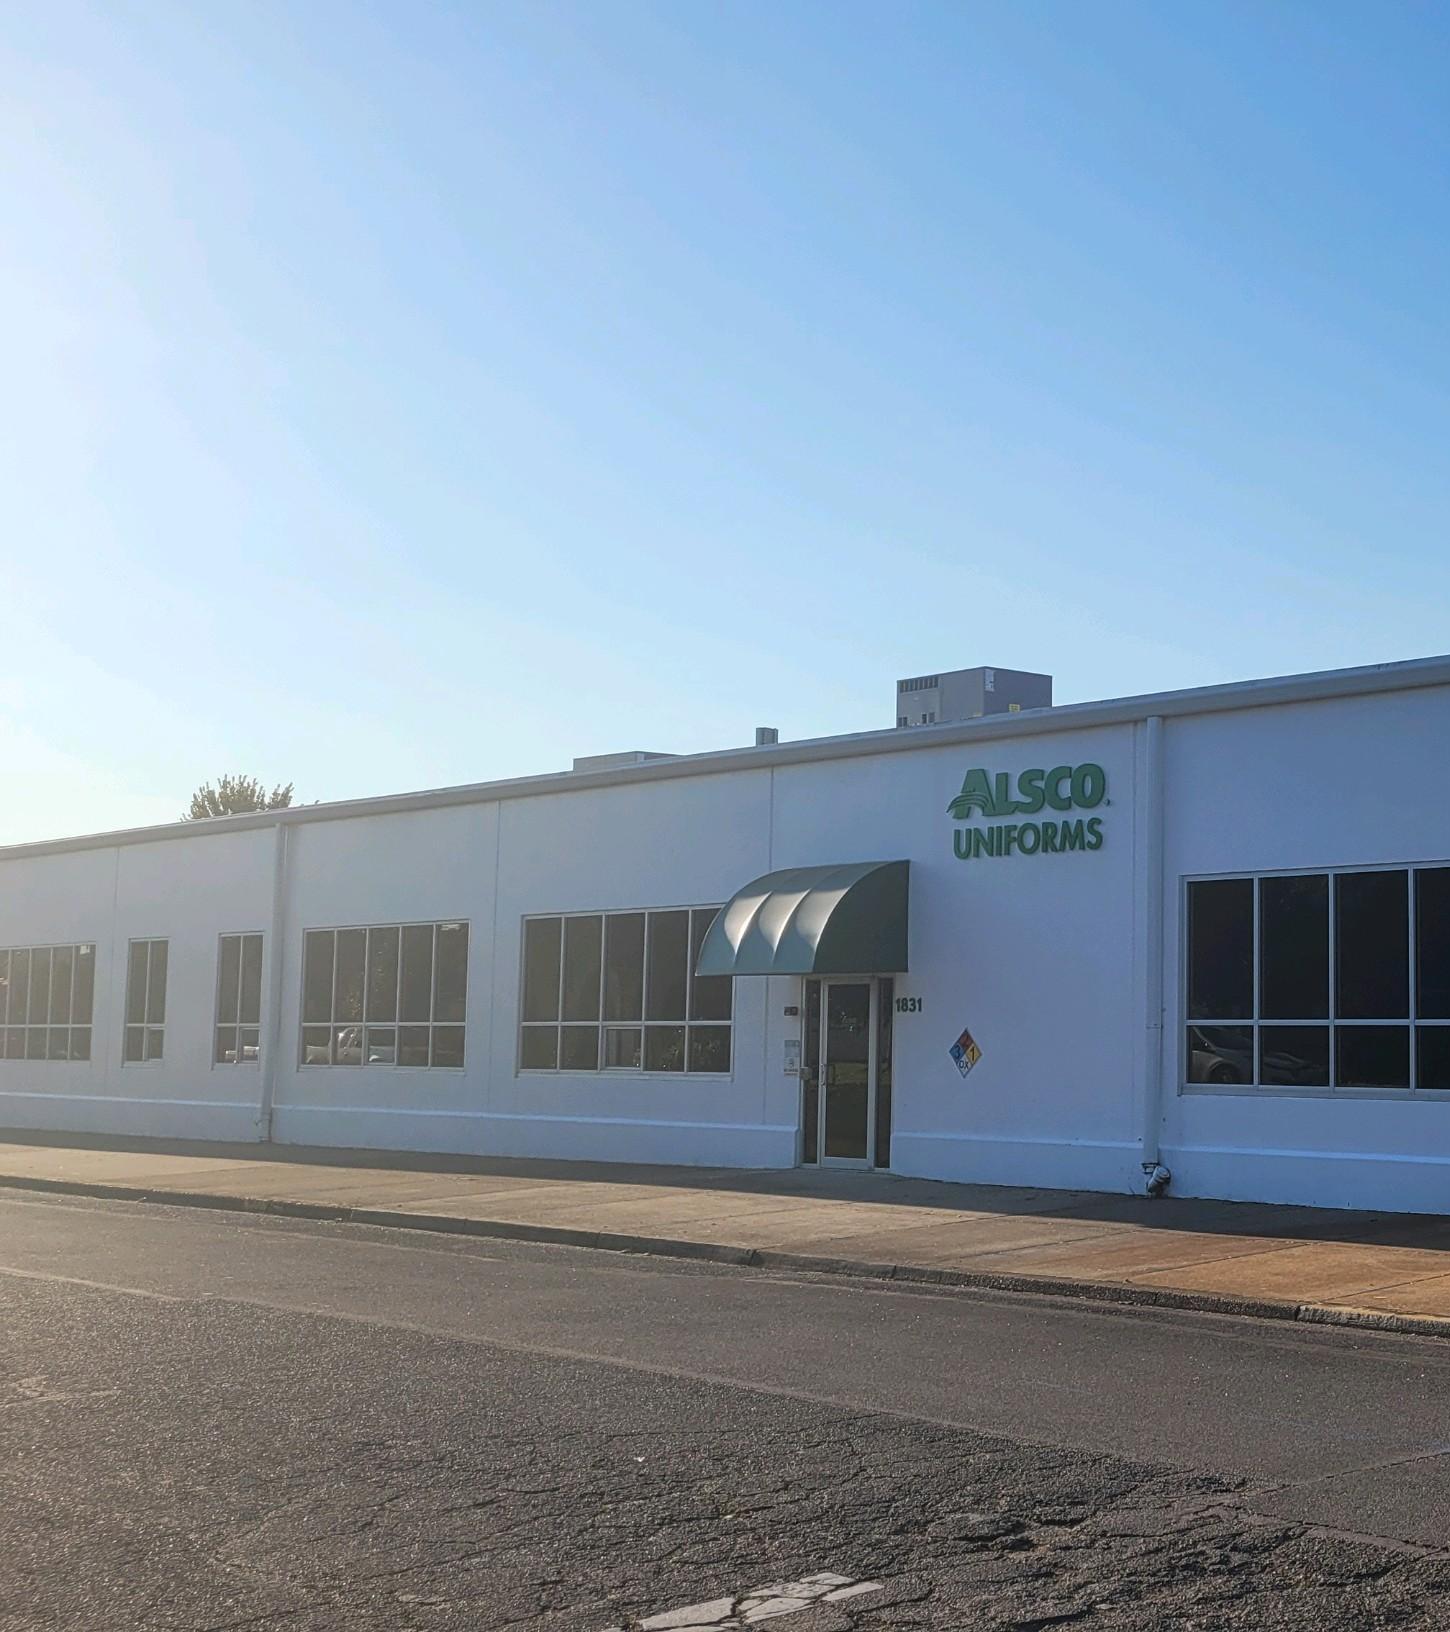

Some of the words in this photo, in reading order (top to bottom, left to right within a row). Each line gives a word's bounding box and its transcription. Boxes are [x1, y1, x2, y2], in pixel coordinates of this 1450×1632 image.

[946, 763, 1106, 819] ALSCO
[953, 817, 1104, 860] UNIFORMS
[895, 997, 922, 1013] 1831
